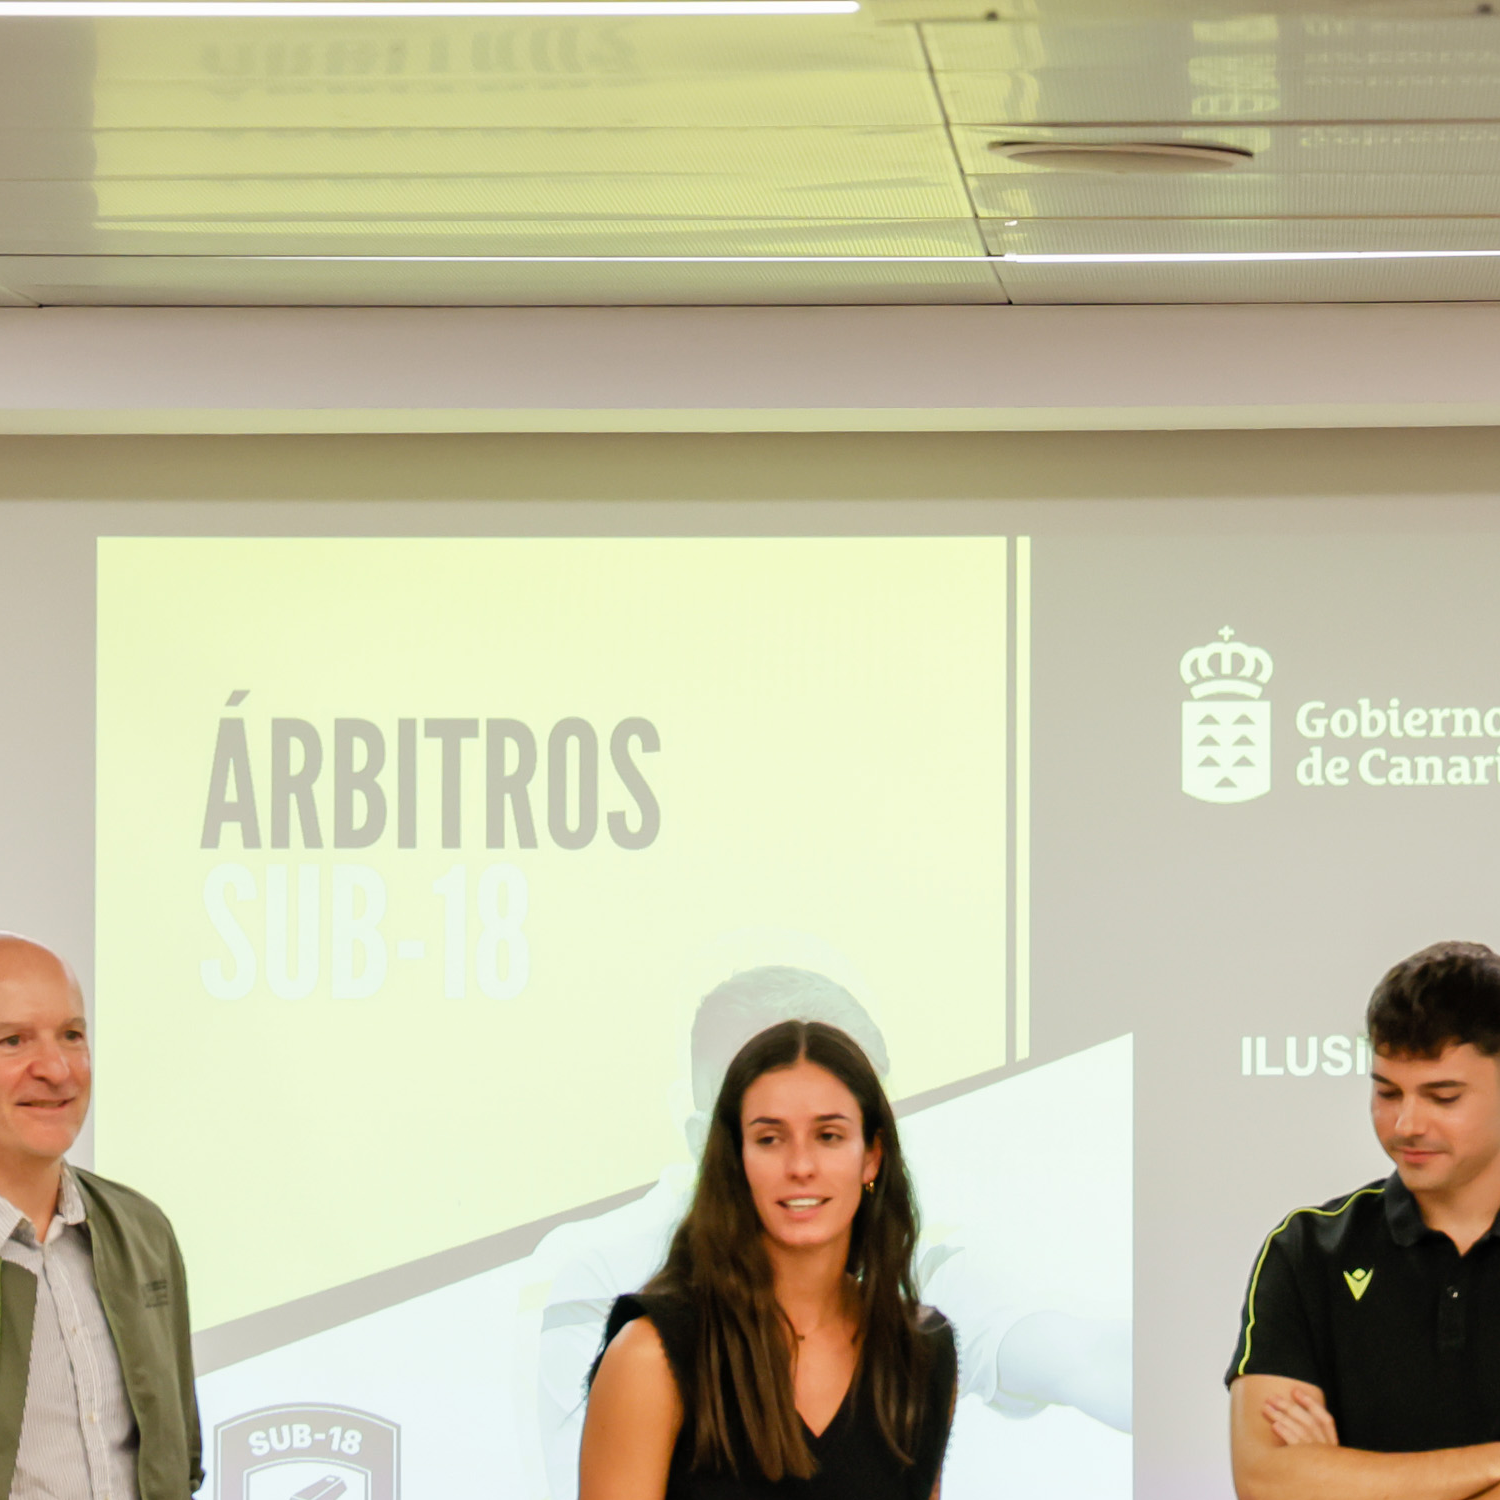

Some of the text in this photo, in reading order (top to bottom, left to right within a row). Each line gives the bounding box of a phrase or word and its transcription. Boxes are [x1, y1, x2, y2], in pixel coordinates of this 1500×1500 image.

[200, 689, 661, 850] ÁRBITROS
[1296, 745, 1350, 786] de
[199, 862, 531, 1001] SUB-18
[1241, 1034, 1373, 1077] ILUSI
[247, 1423, 363, 1456] SUB-18
